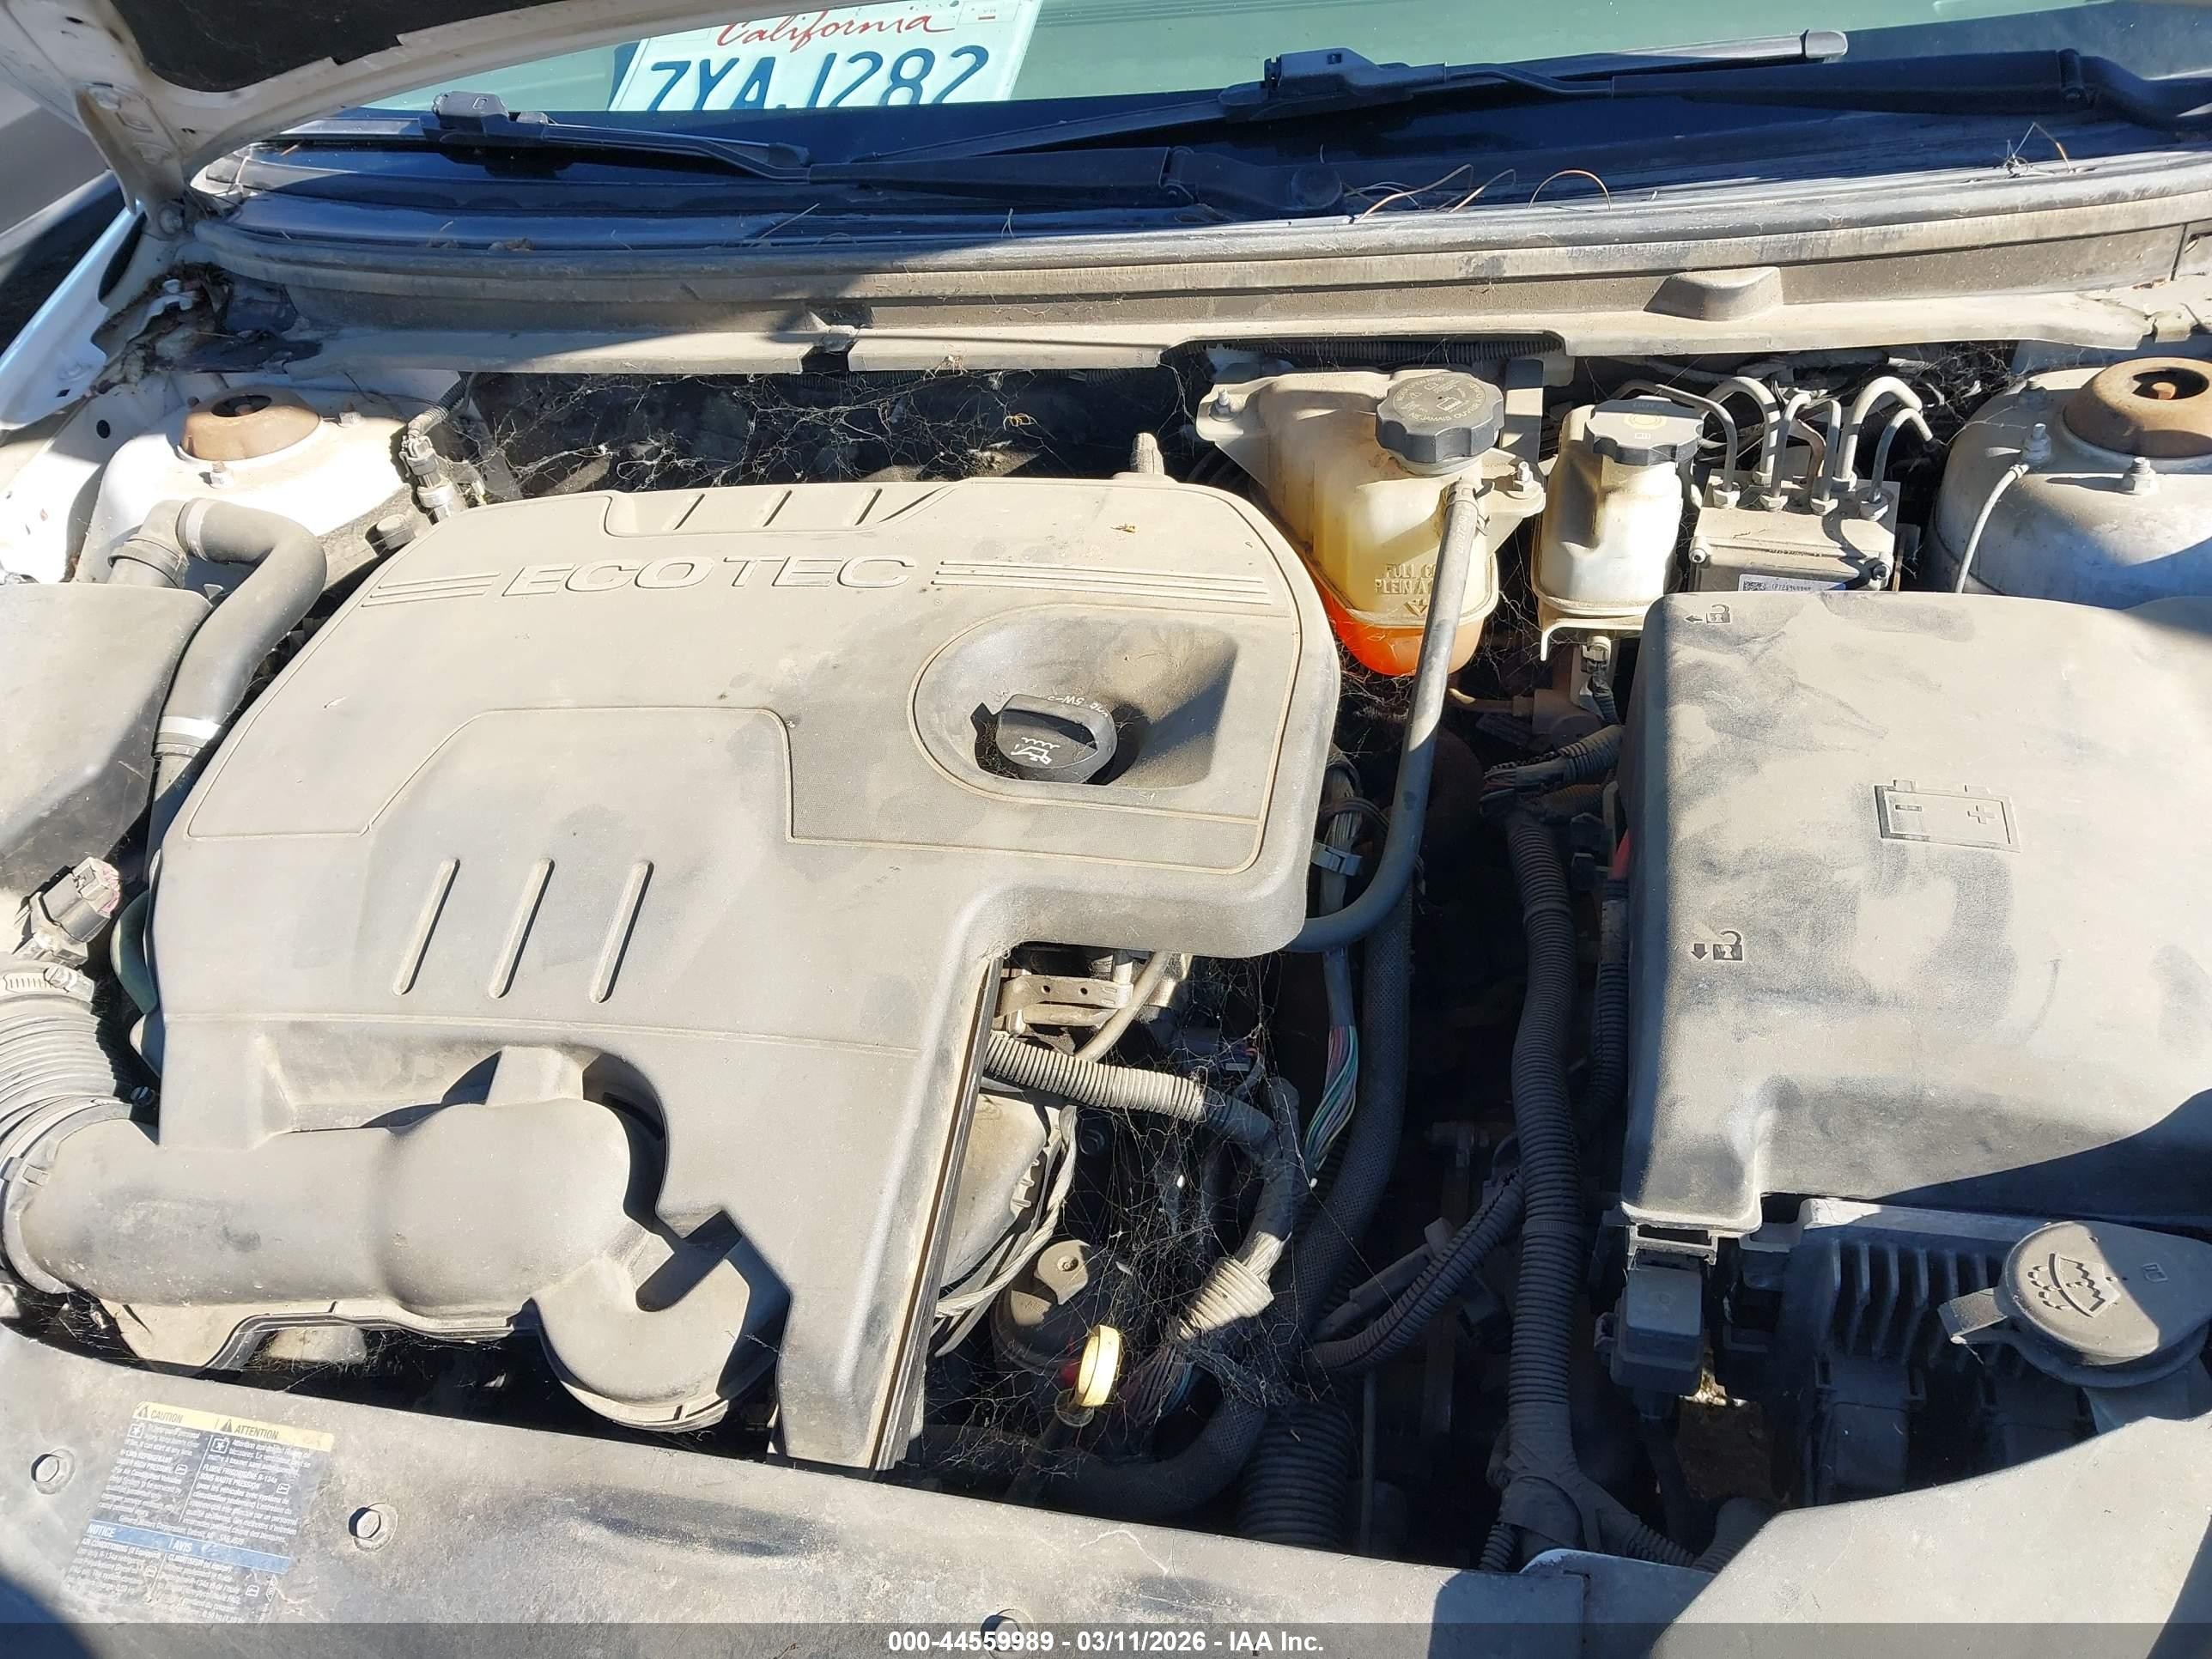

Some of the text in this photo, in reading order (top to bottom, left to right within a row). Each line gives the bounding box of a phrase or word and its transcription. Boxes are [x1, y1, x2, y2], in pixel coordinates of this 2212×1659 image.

[715, 10, 954, 53] California
[150, 1409, 184, 1424] CAUTION
[234, 1424, 279, 1440] ATTENTION
[87, 1523, 116, 1538] NOTICE
[173, 1540, 192, 1553] AVIS
